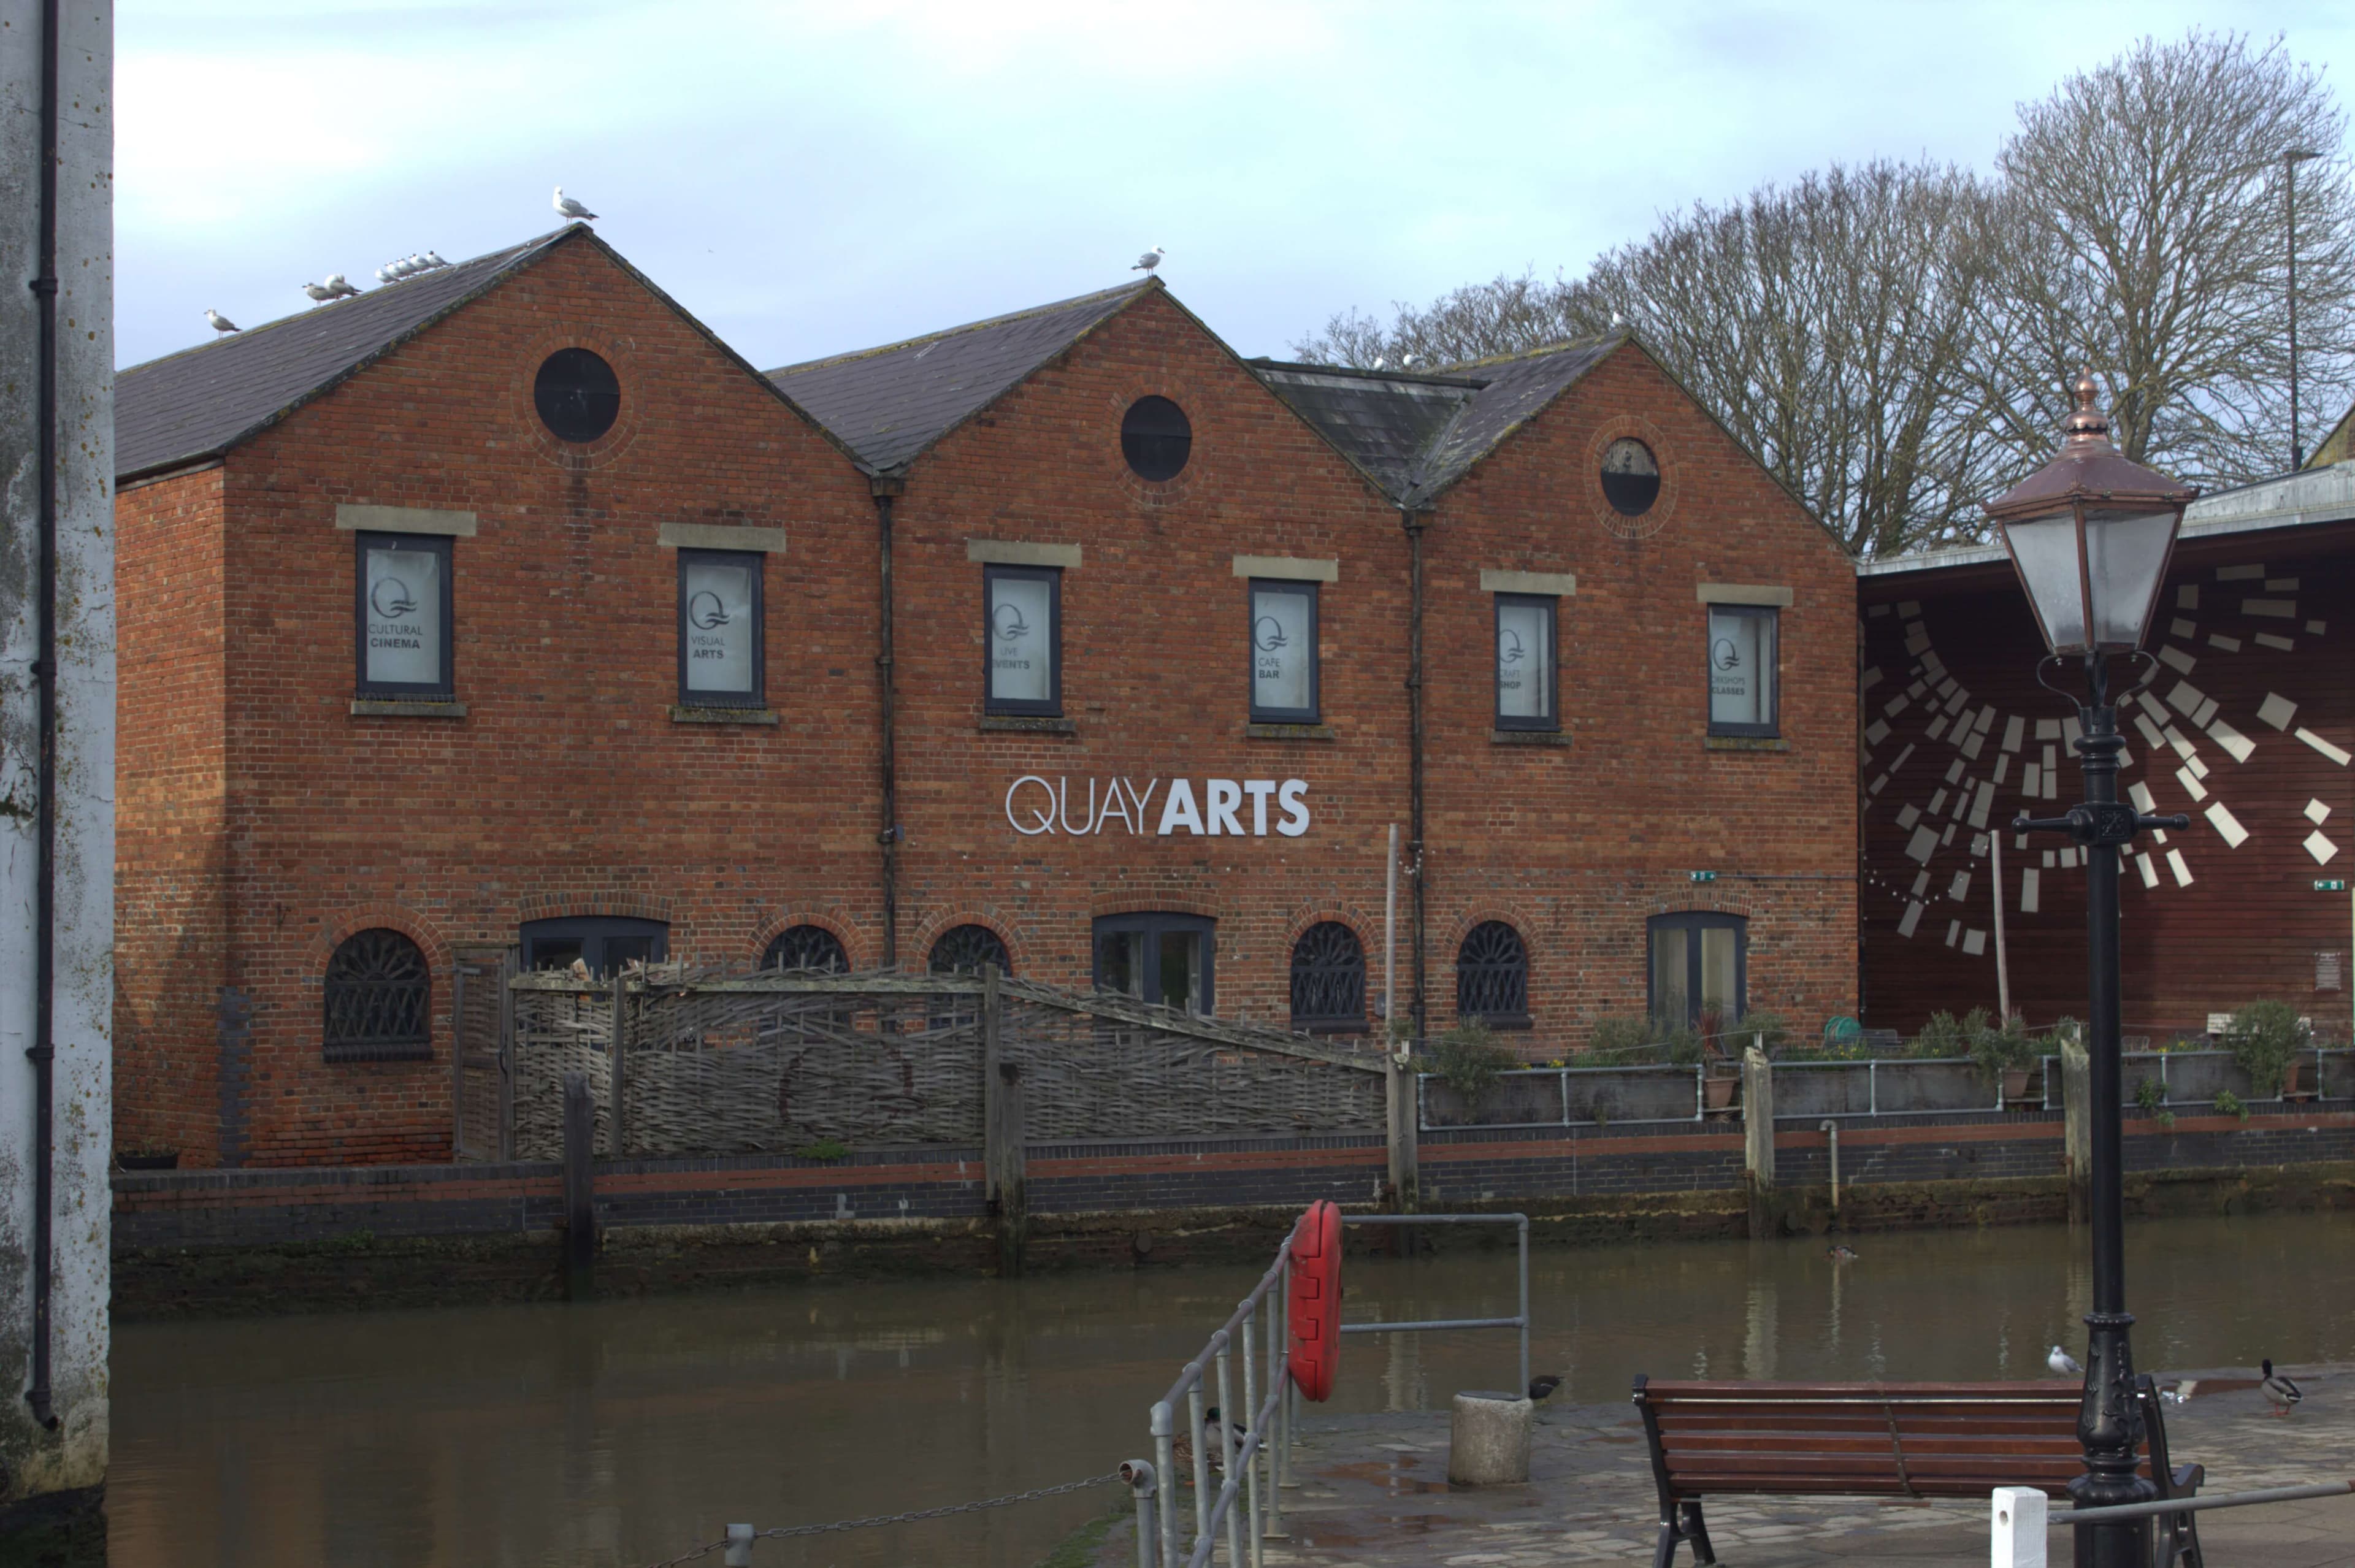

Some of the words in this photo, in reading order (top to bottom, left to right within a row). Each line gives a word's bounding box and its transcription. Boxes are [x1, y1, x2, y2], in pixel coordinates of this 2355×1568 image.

[368, 624, 423, 635] CULTURAL
[370, 638, 420, 649] CINEMA
[691, 636, 726, 646] VISUAL
[693, 649, 725, 659] ARTS
[1001, 647, 1018, 657] LIVE
[992, 659, 1030, 670] EVENTS
[1258, 657, 1281, 667] CAFE
[1259, 669, 1280, 679] BAR
